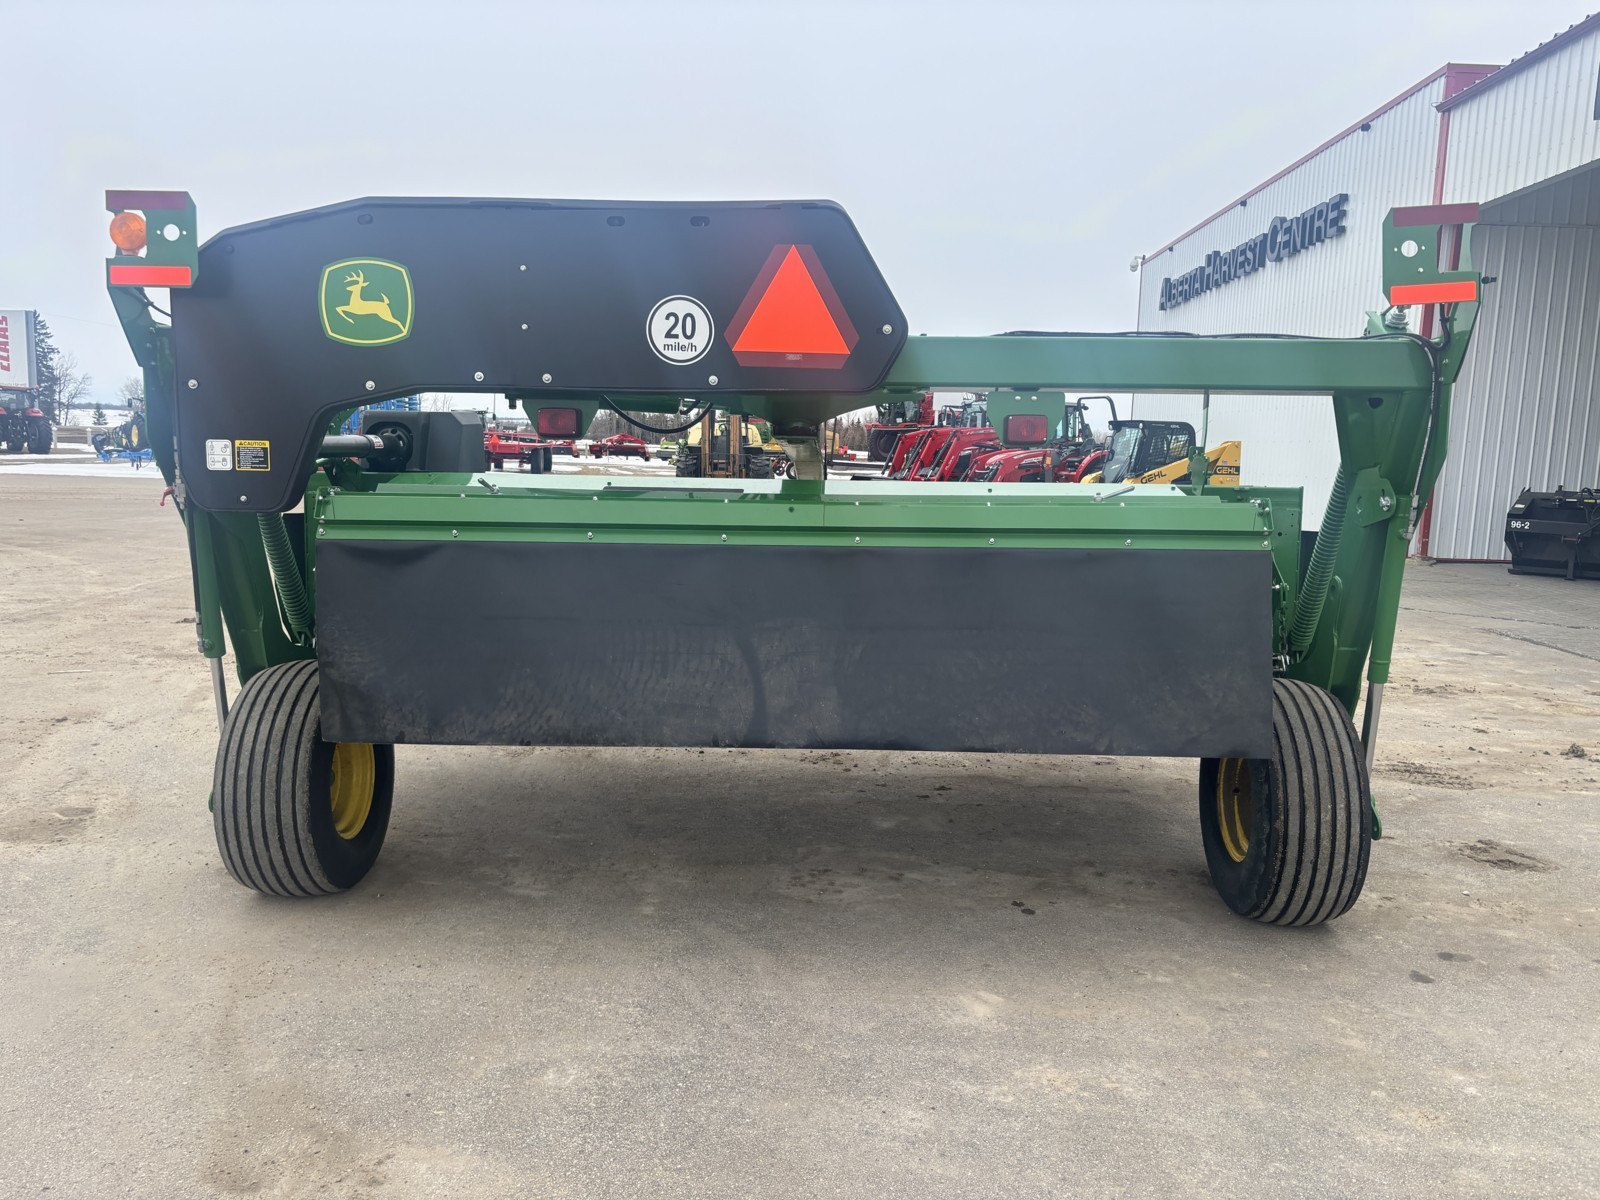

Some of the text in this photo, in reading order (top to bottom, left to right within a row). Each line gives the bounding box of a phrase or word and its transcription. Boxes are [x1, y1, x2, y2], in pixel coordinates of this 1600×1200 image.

[1159, 193, 1348, 311] ALBERTA HARVEST CENTRE
[664, 311, 697, 340] 20
[663, 342, 697, 352] mile/h
[1141, 470, 1167, 484] GEHL
[1510, 521, 1530, 529] 96-2
